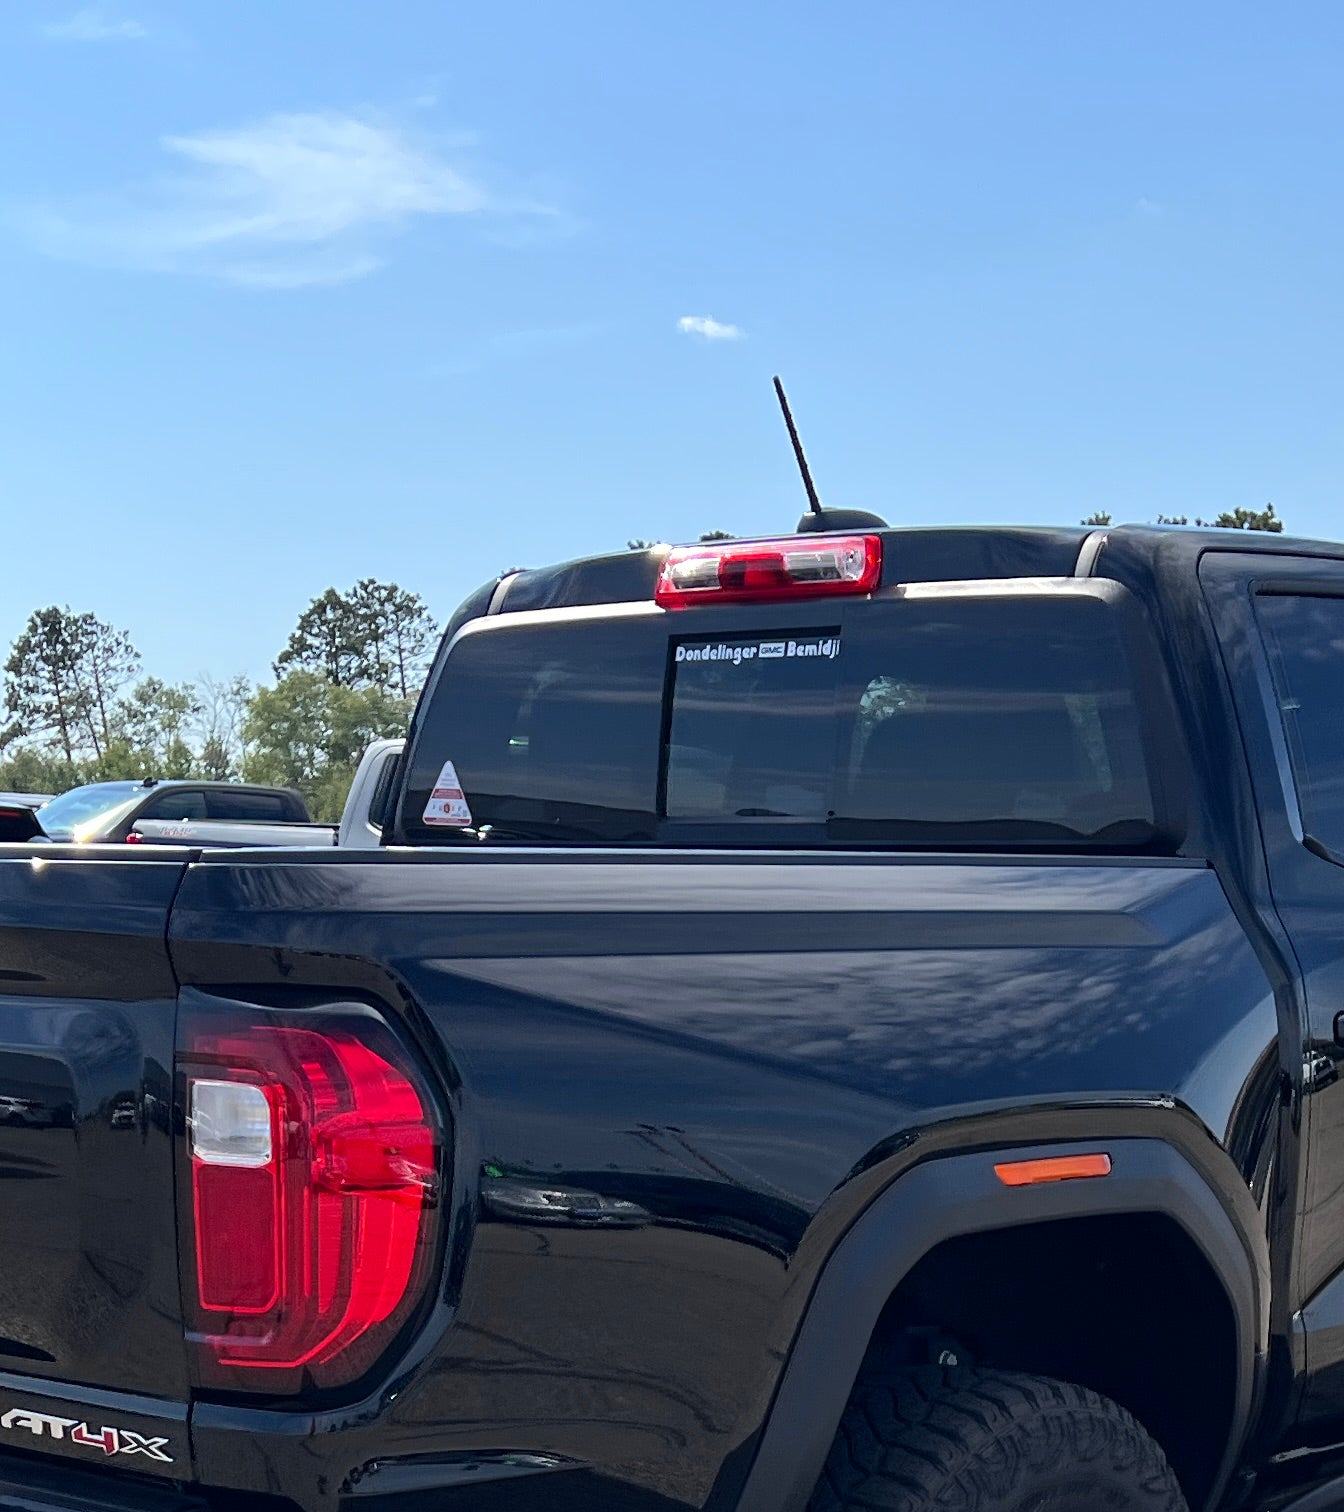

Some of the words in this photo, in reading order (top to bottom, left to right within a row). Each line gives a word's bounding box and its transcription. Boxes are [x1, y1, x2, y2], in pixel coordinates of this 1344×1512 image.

[675, 645, 757, 665] Dondelinger
[786, 639, 841, 659] Bemidji
[0, 1407, 174, 1463] AT4X
